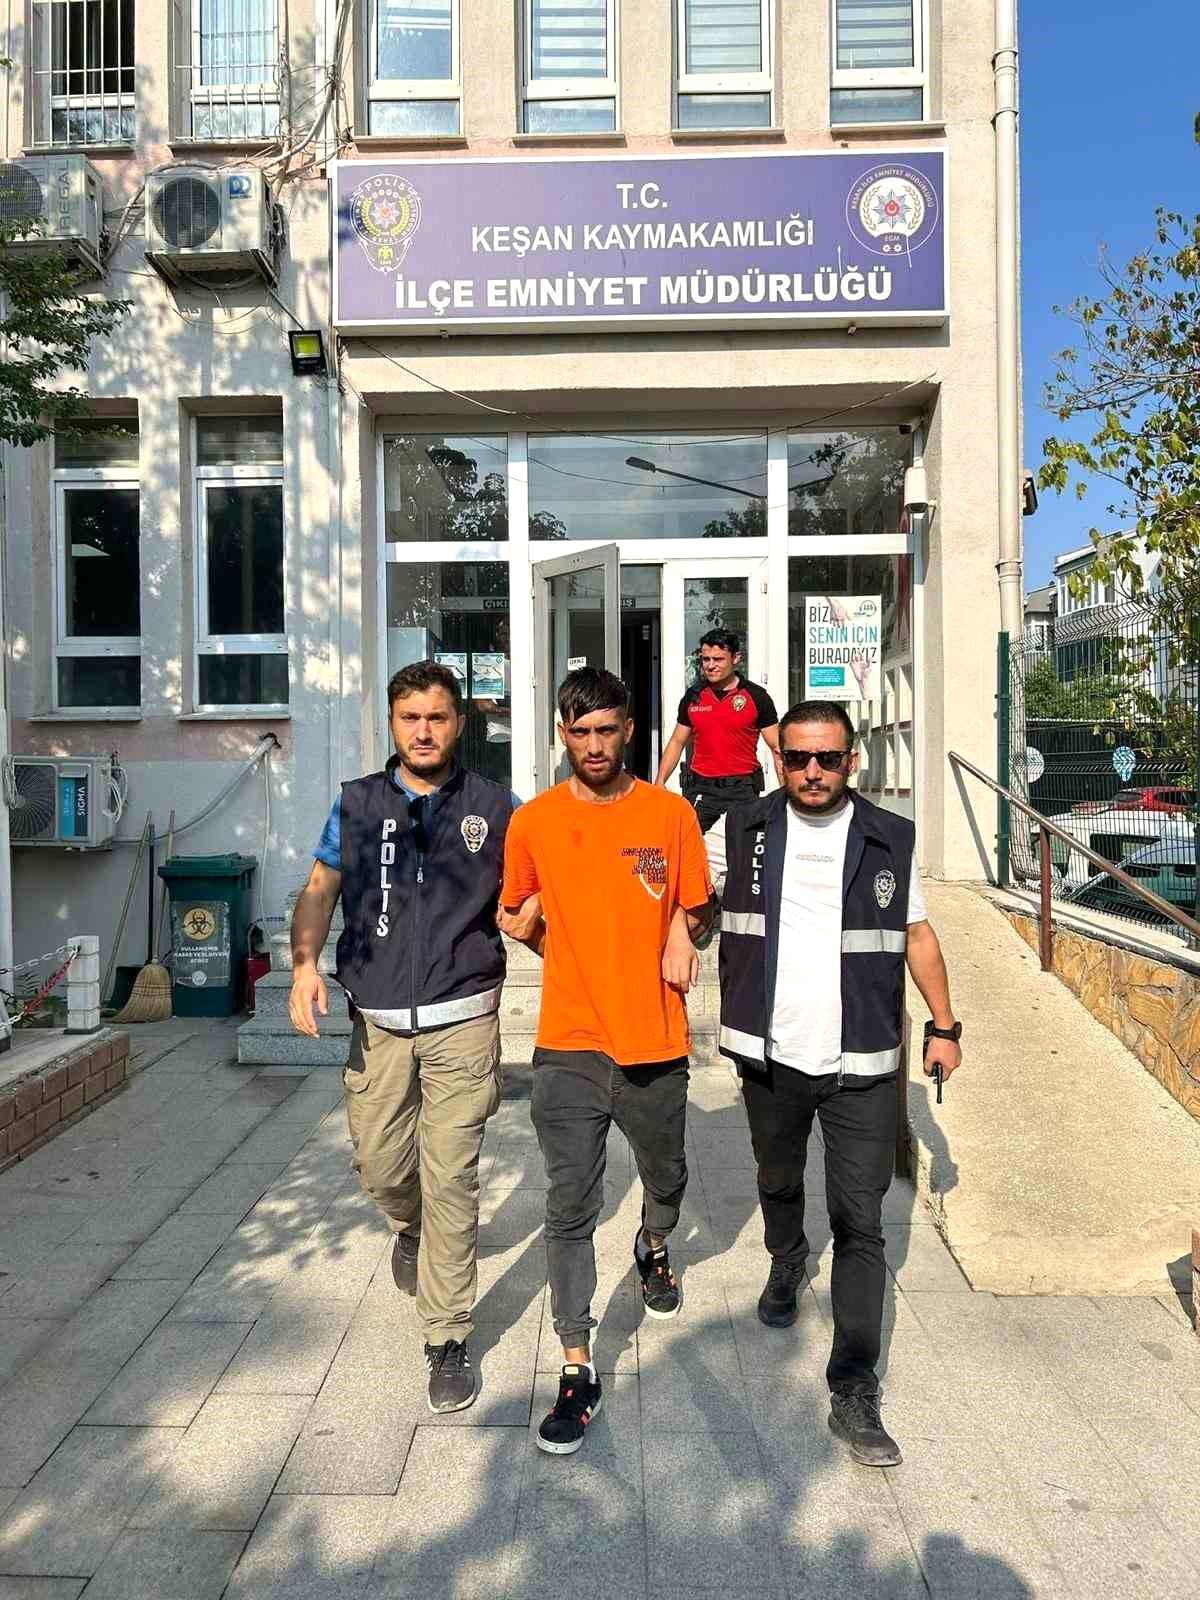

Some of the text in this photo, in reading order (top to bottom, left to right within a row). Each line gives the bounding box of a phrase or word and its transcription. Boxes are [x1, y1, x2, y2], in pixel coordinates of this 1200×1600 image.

[616, 183, 668, 209] T.C.
[471, 213, 814, 257] KEŞAN KAYMAKAMLIĞI
[395, 264, 892, 315] İLÇE EMNİYET MÜDÜRLÜĞÜ
[809, 624, 878, 645] SENİN İÇİN
[77, 786, 86, 816] SIGMA
